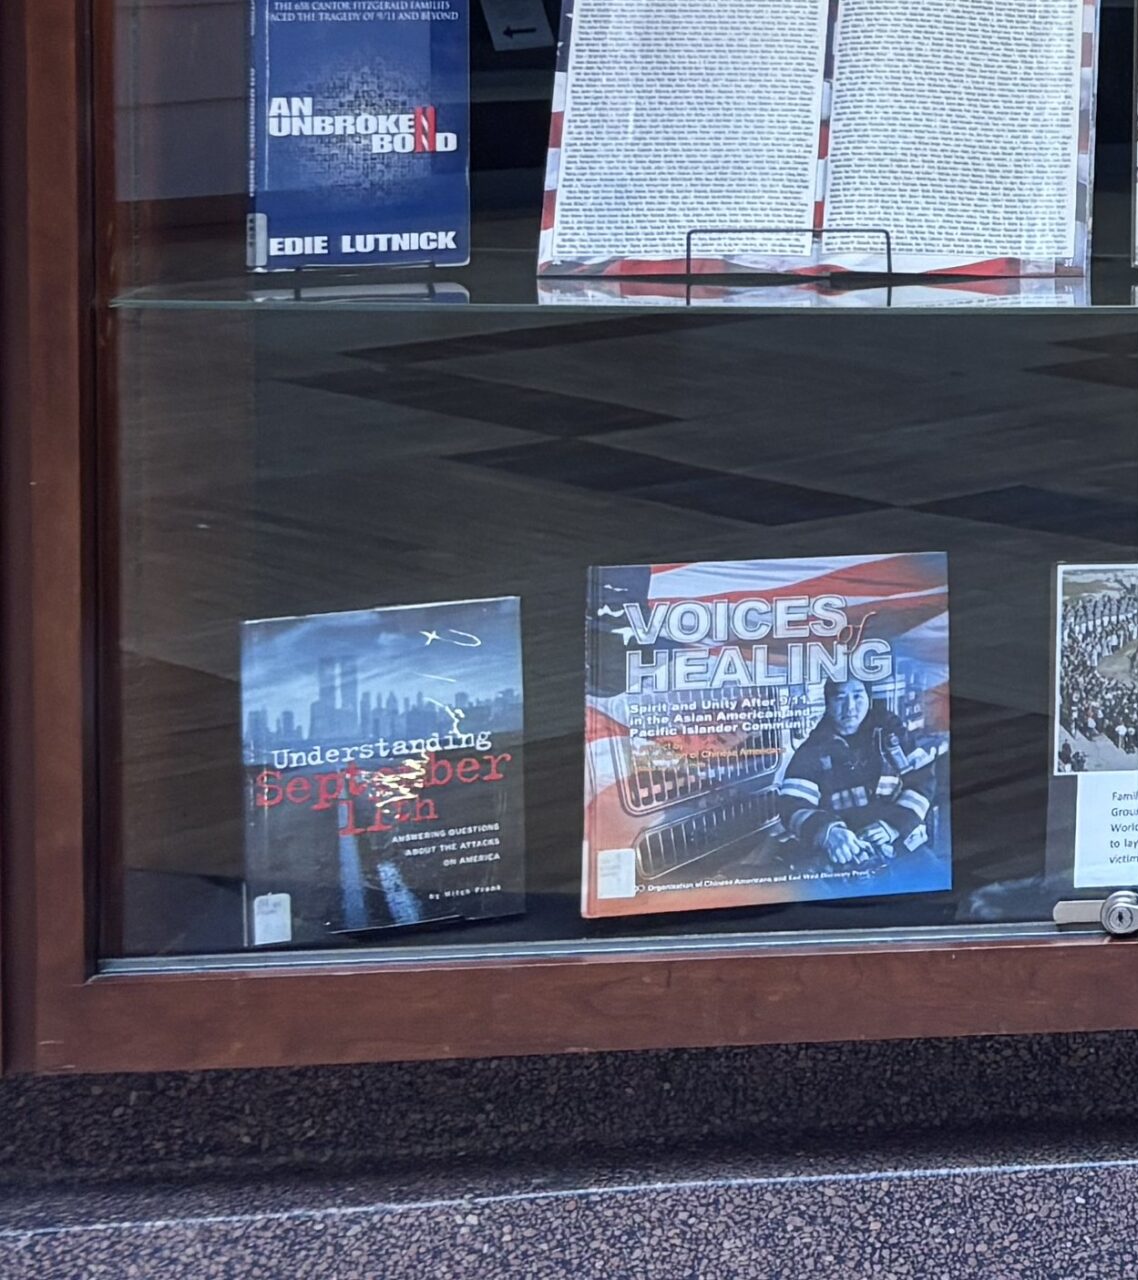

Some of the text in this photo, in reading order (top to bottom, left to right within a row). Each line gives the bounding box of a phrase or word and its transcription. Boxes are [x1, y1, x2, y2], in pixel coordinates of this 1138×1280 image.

[268, 11, 295, 21] ACED
[297, 12, 316, 21] THE
[398, 11, 420, 21] AND
[274, 1, 293, 11] THE
[269, 96, 313, 116] AN
[268, 106, 436, 136] UNBROKEN
[372, 131, 458, 153] BOND
[269, 231, 458, 256] EDIE LUTNICK
[622, 594, 848, 645] VOICES
[834, 611, 876, 653] of
[625, 638, 893, 694] HEALING
[630, 702, 668, 715] Spirit
[671, 701, 697, 712] and
[701, 698, 738, 712] Unity
[741, 697, 776, 708] After
[630, 716, 643, 726] in
[646, 714, 669, 725] the
[673, 711, 713, 723] Asian
[716, 709, 782, 722] American
[629, 720, 818, 738] Pacific Islander Community
[271, 730, 492, 769] Understanding
[255, 752, 512, 810] Septber
[391, 822, 500, 844] ANSWERING QUESTIONS
[1110, 822, 1138, 833] World
[404, 837, 500, 857] ABOUT THE ATTACKS
[1110, 839, 1121, 849] to
[1123, 838, 1138, 852] lay
[458, 852, 501, 865] AMERICA
